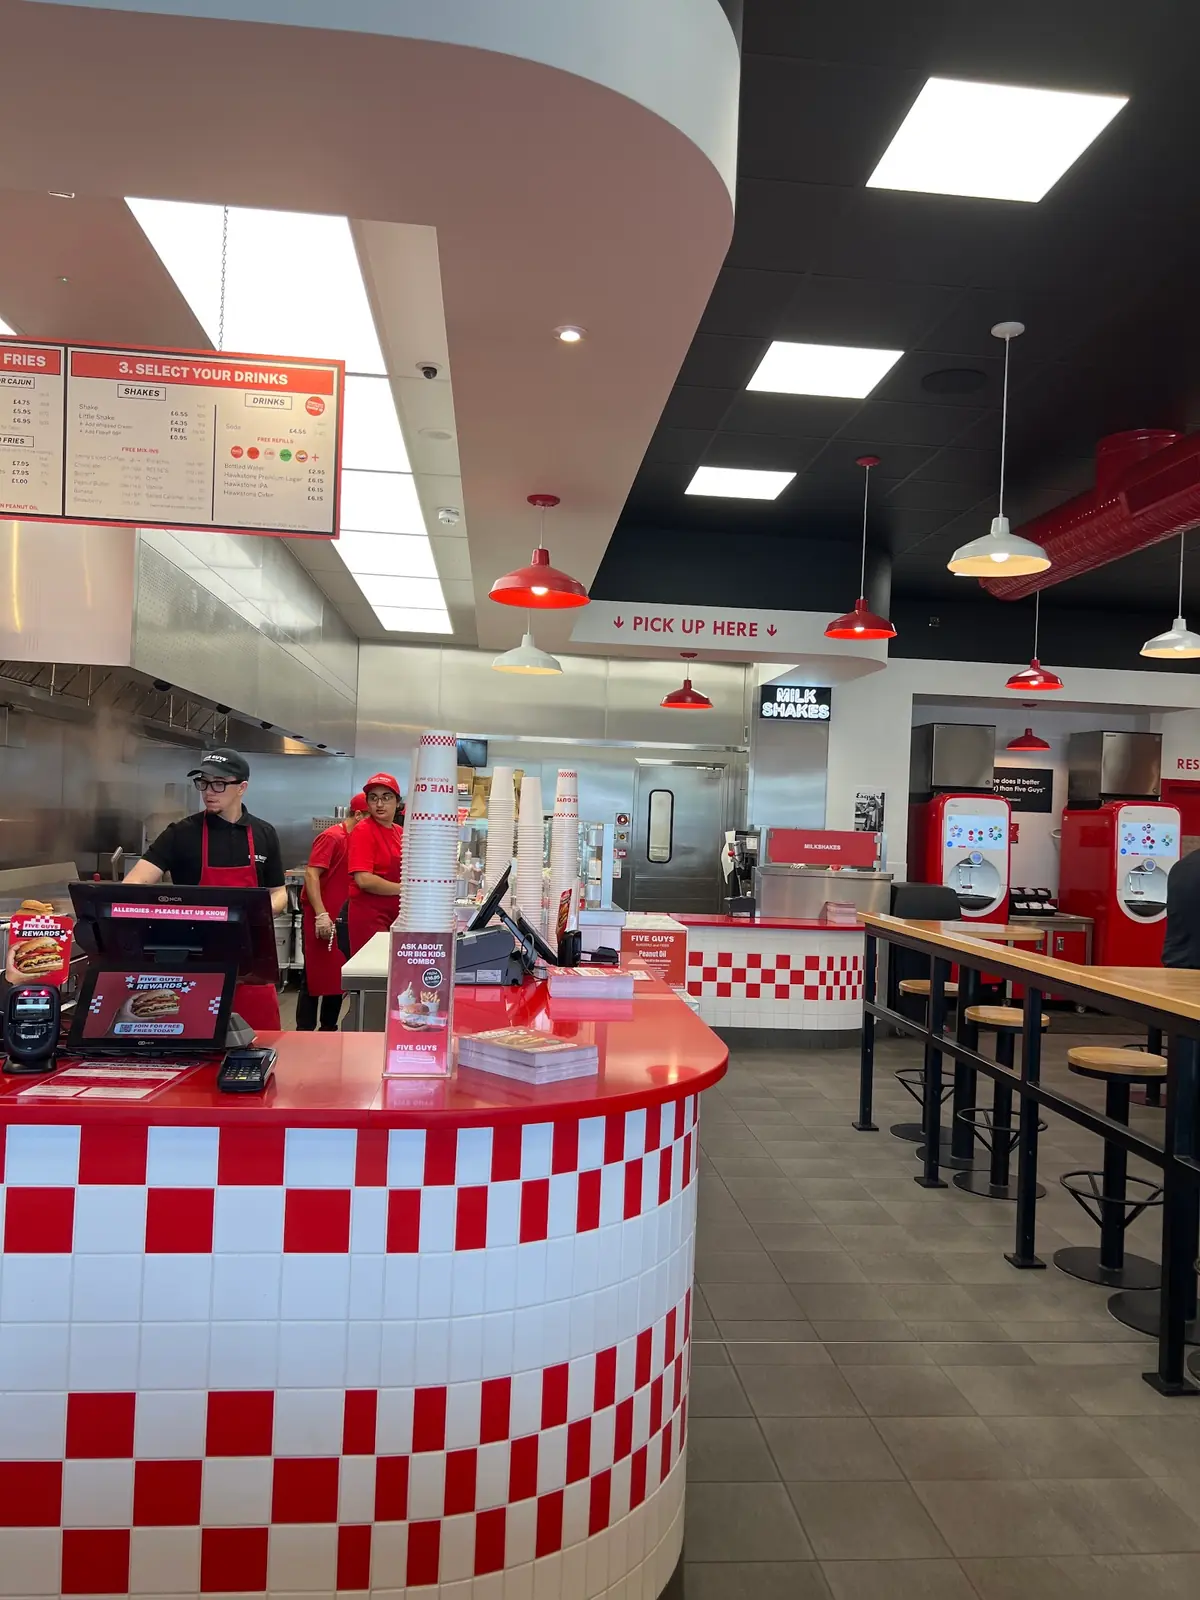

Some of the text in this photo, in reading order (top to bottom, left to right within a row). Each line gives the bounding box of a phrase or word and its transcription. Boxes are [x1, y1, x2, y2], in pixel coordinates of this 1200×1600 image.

[3, 353, 46, 367] FRIES
[118, 361, 289, 385] 3. SELECT YOUR DRINKS
[7, 378, 32, 386] CAJUN
[124, 387, 160, 397] SHAKES
[252, 397, 285, 406] DRINKS
[79, 403, 99, 411] Shake
[633, 616, 758, 637] PICK UP HERE
[776, 687, 817, 703] MILK
[762, 702, 830, 719] SHAKES
[430, 784, 454, 793] FIVE
[113, 906, 150, 914] ALLERGIES
[651, 935, 675, 943] GUYS
[638, 950, 658, 958] Peanut
[136, 982, 182, 990] REWARDS
